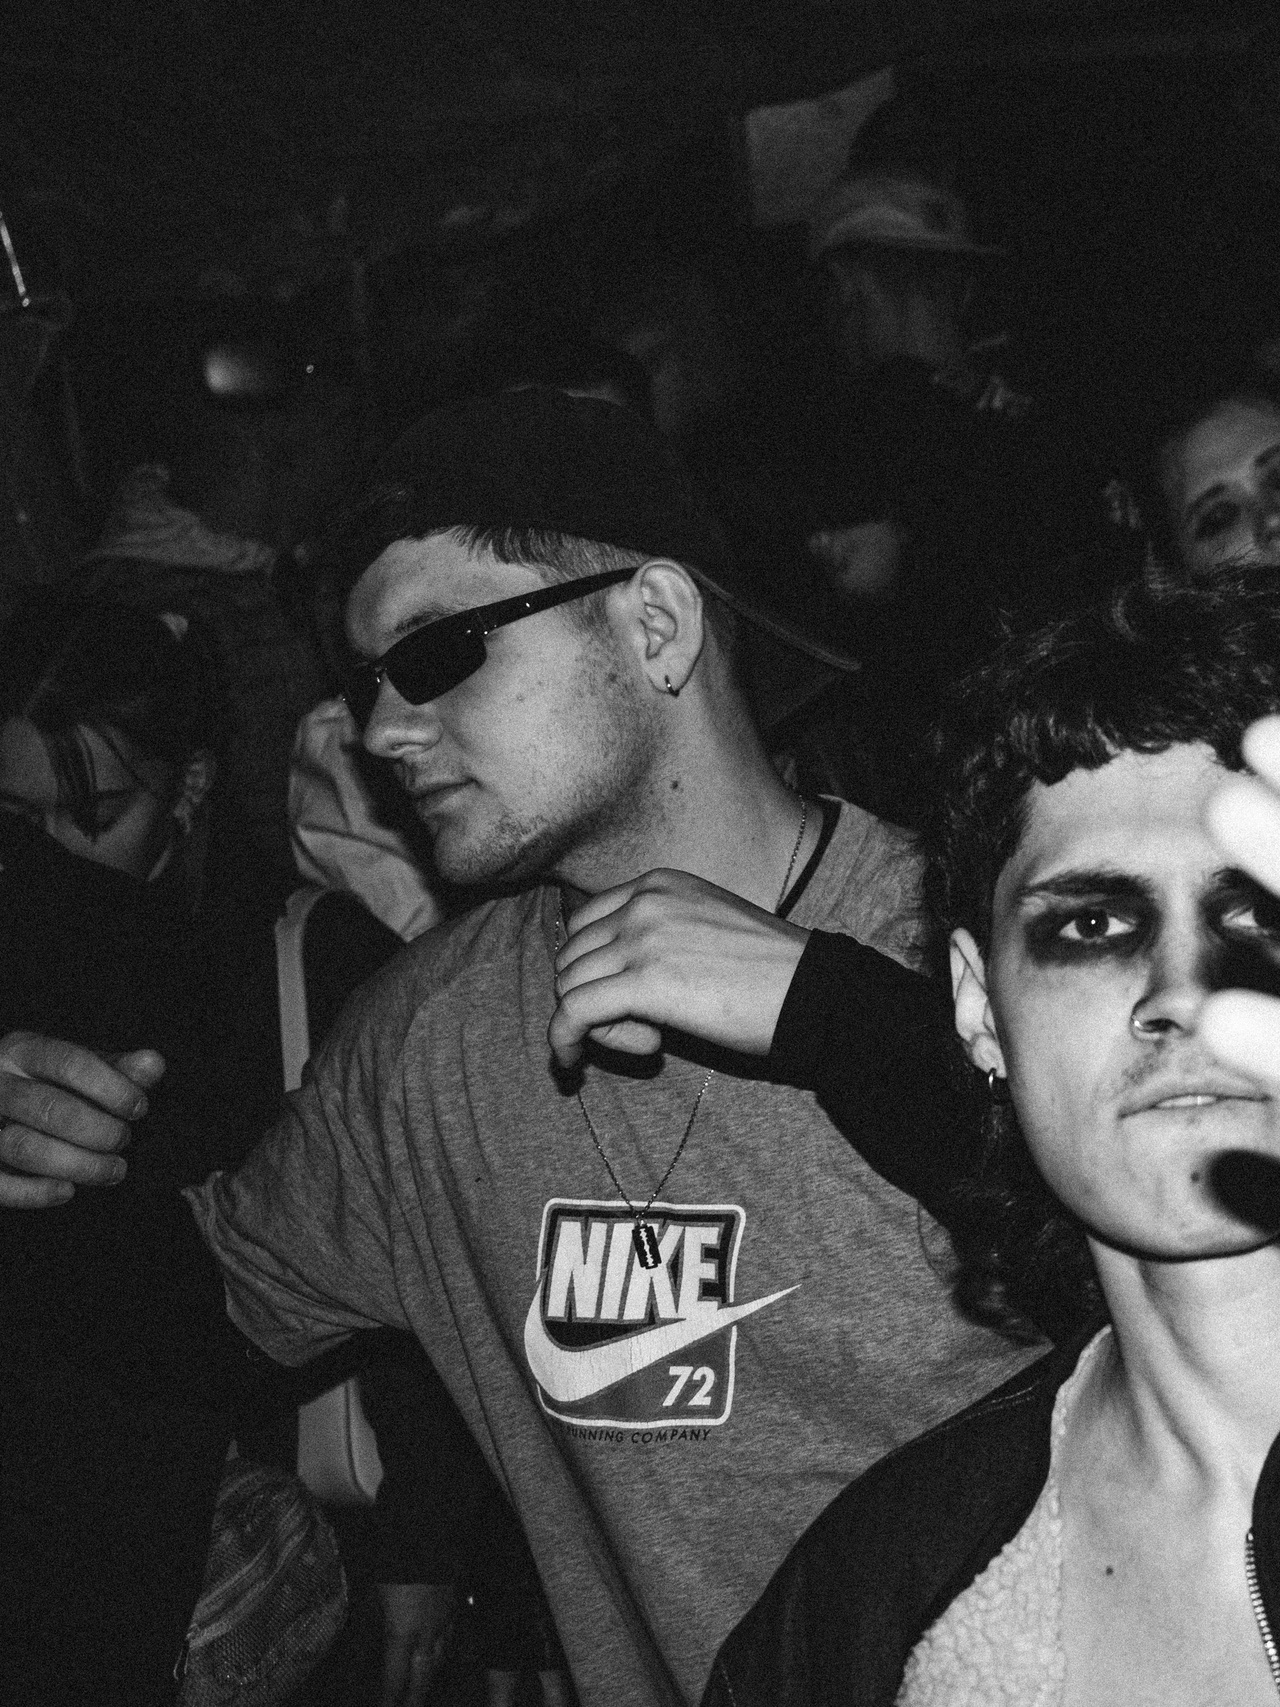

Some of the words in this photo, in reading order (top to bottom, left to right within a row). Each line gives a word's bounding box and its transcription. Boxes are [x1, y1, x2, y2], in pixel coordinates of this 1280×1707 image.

[547, 1221, 720, 1320] NIKE
[661, 1365, 716, 1407] 72
[630, 1428, 712, 1444] COMPANY
